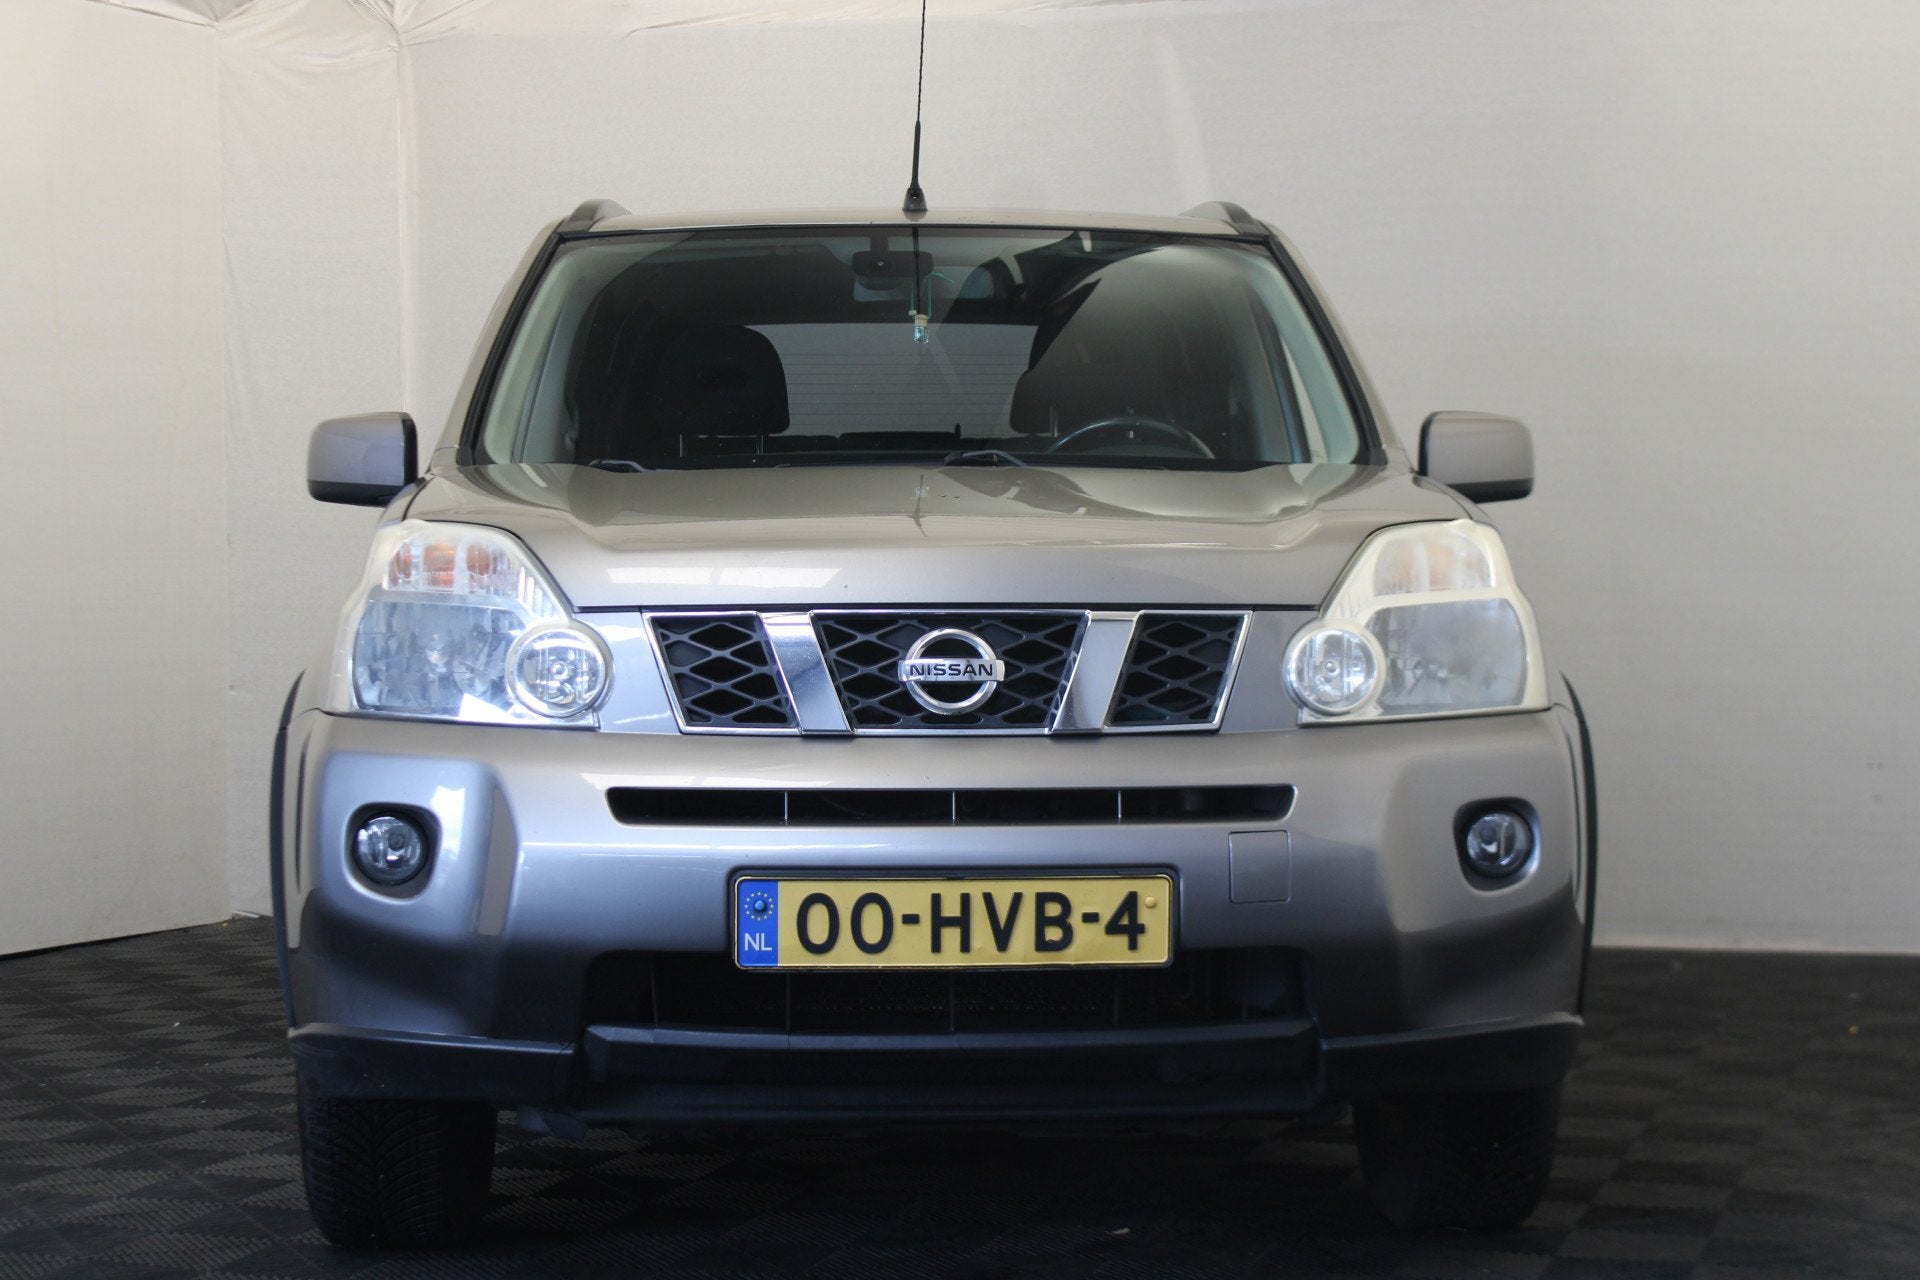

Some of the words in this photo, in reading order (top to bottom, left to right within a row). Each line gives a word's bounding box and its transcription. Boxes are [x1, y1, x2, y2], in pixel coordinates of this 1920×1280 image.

[910, 664, 993, 676] NISSAN
[796, 891, 1146, 954] 00-HVB-4
[744, 933, 772, 951] NL
